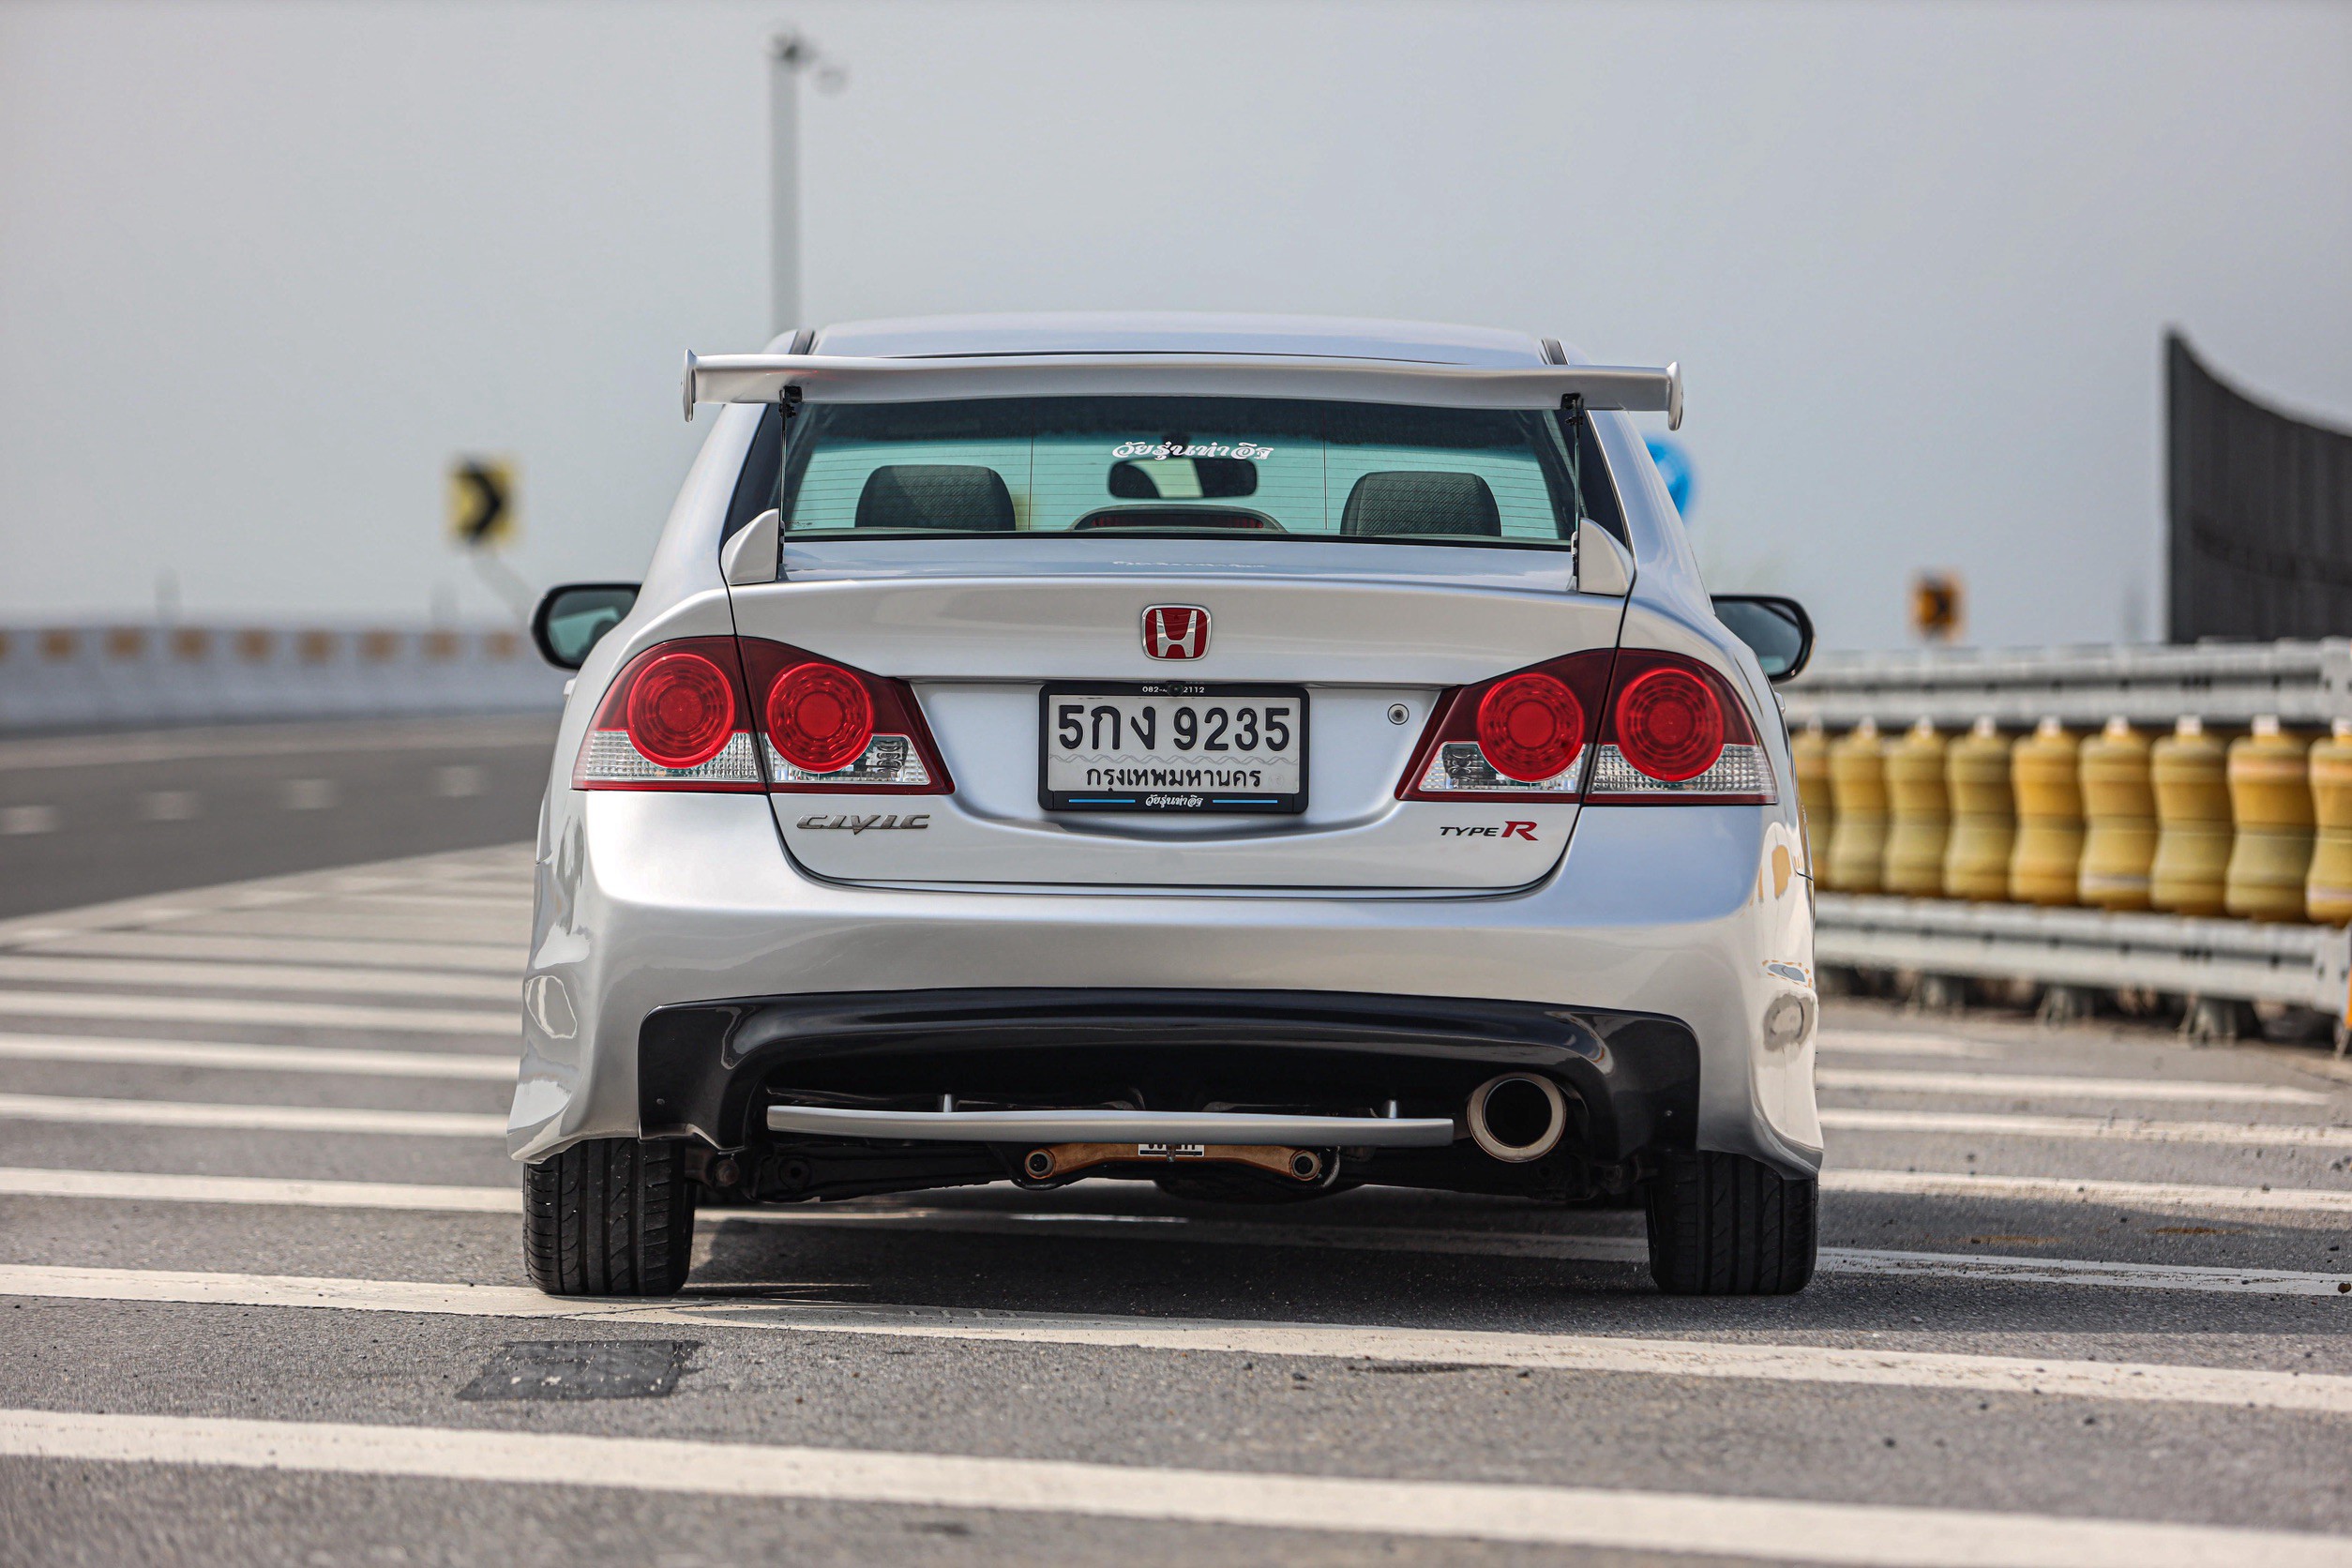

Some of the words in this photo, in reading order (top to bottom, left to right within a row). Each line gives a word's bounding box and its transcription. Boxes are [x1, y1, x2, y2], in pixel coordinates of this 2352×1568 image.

[1058, 704, 1156, 750] 5กง
[1173, 706, 1290, 751] 9235
[1086, 767, 1261, 792] กรุงเทพมหานคร
[796, 814, 930, 836] CIVIC
